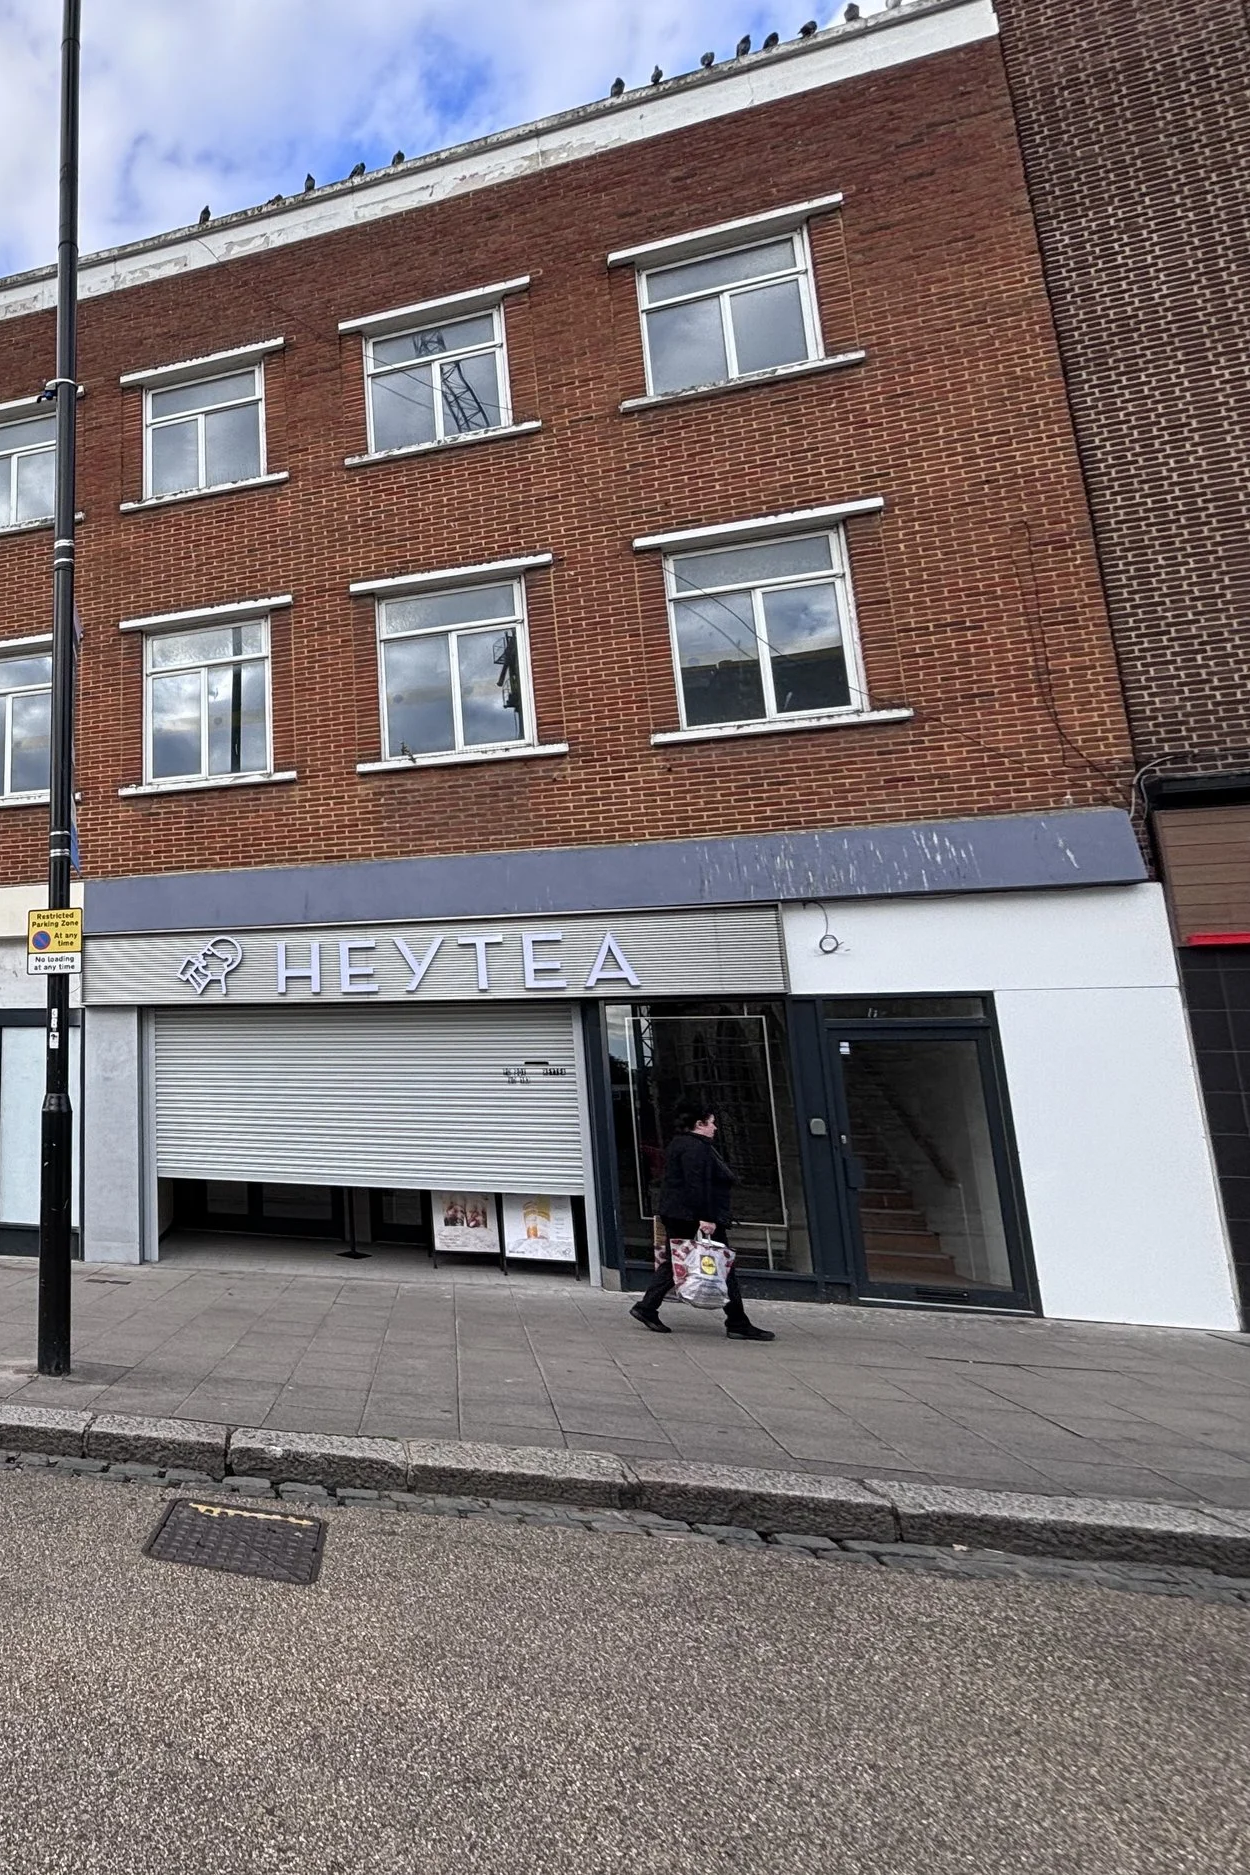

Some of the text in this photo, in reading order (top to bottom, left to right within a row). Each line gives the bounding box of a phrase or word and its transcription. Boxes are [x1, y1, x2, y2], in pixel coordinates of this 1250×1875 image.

[36, 912, 74, 920] Restricted
[48, 955, 75, 963] loading
[276, 930, 642, 995] HEYTEA
